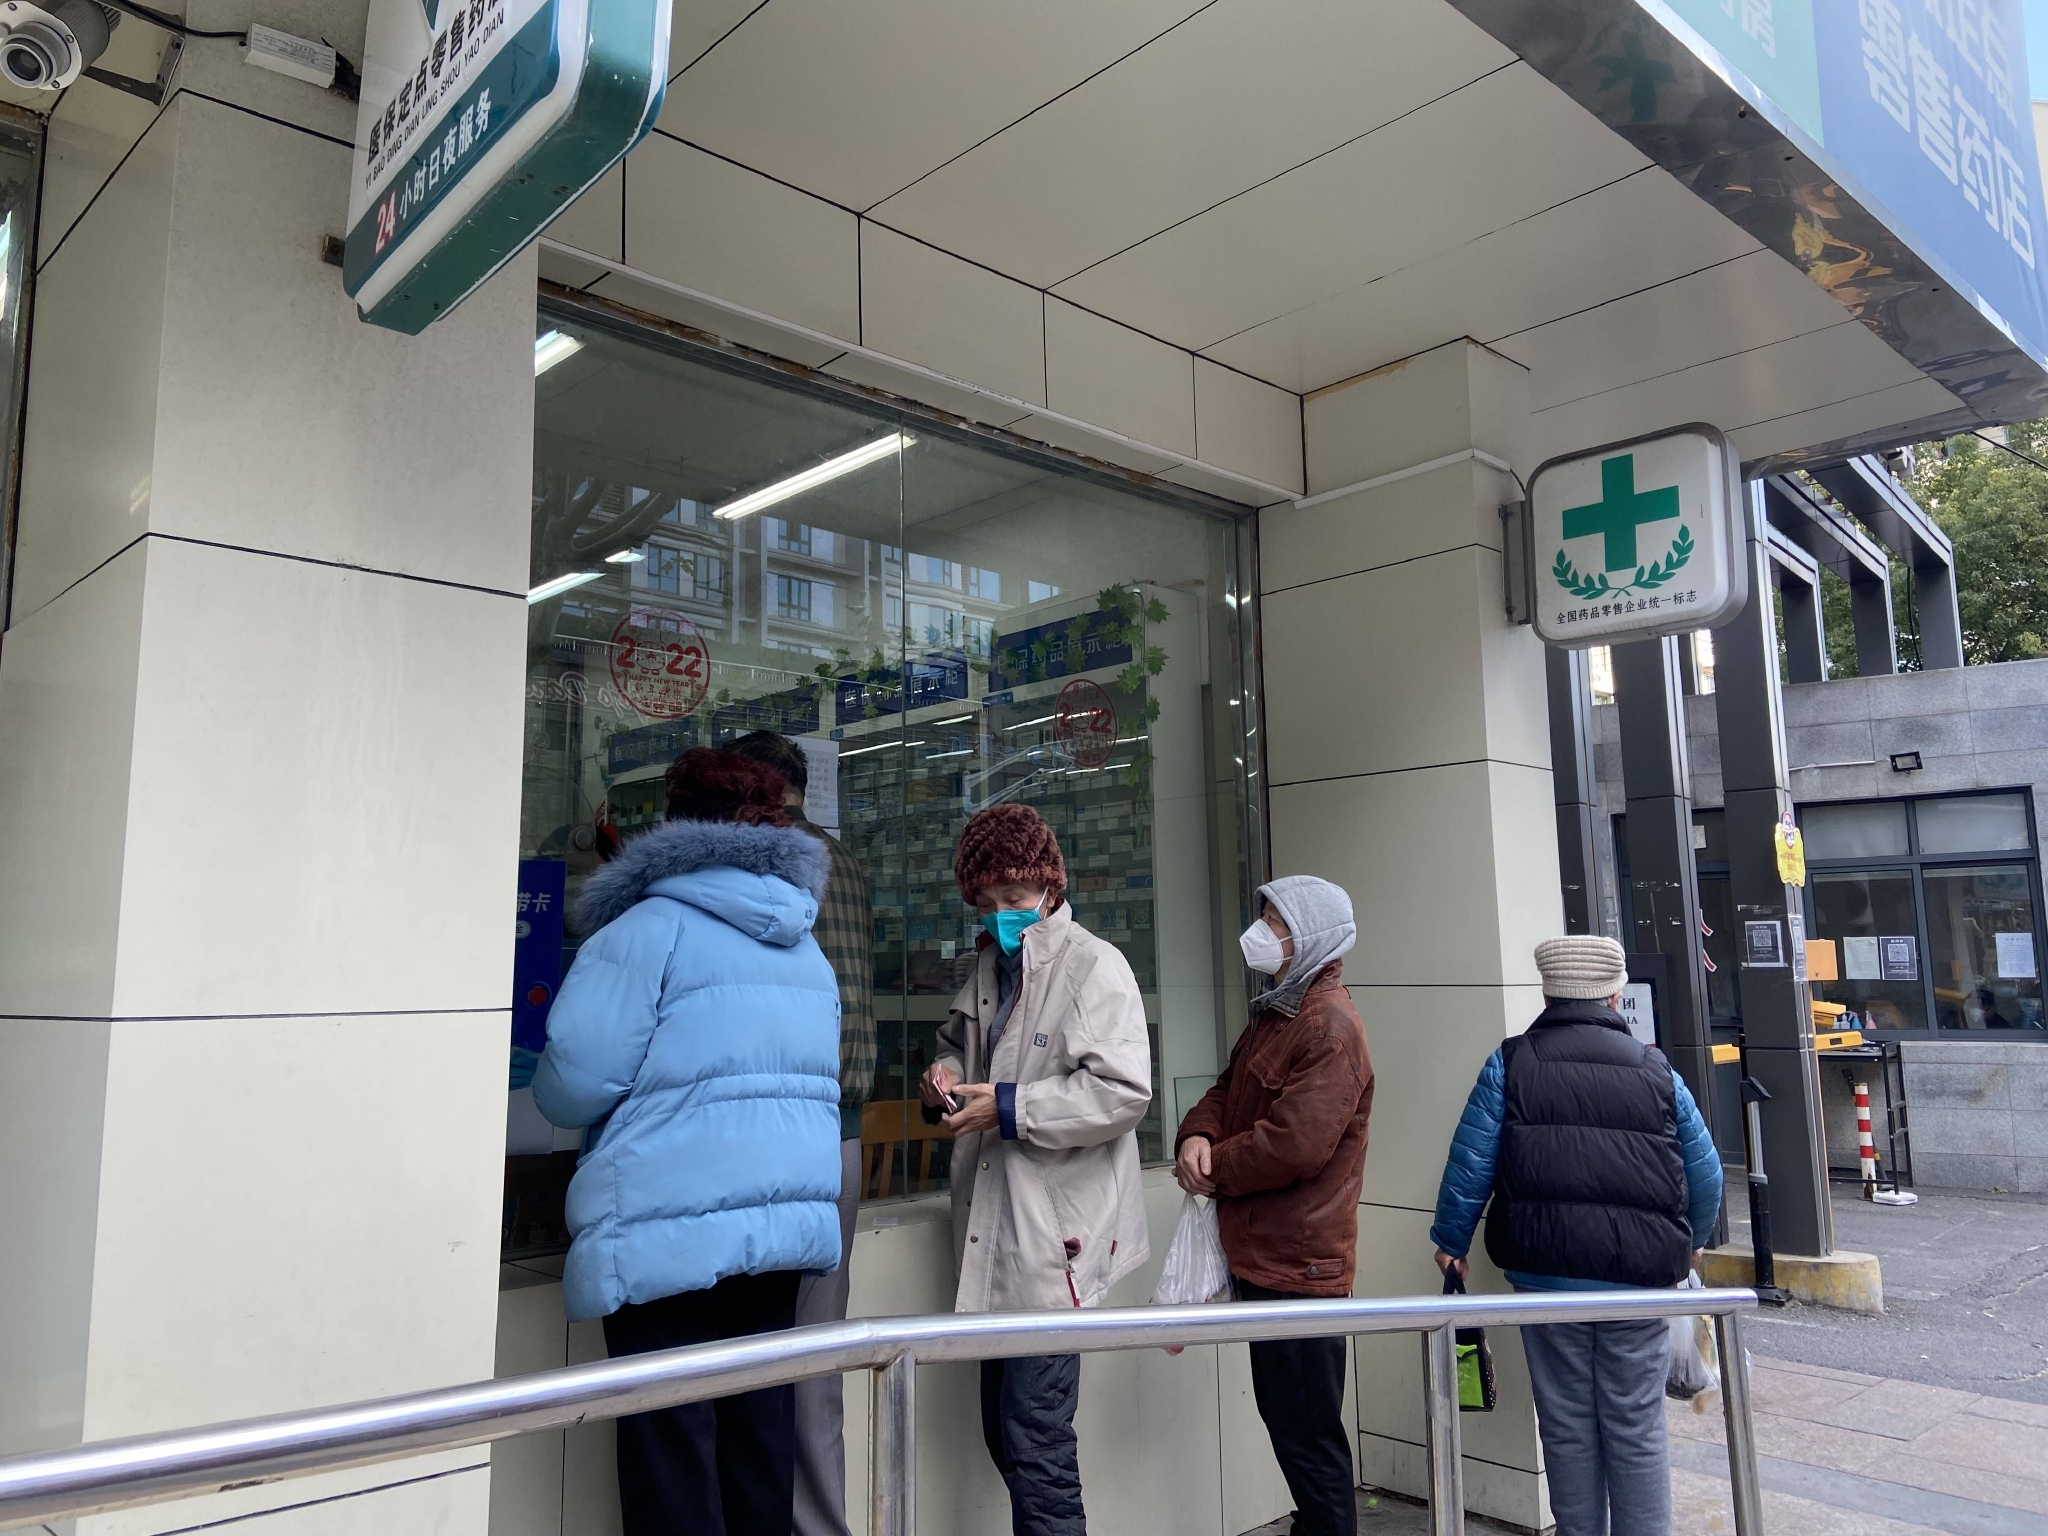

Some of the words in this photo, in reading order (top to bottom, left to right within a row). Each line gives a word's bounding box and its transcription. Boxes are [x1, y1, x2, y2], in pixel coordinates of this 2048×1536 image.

[365, 173, 373, 190] YI
[373, 157, 386, 182] BAO
[387, 134, 403, 164] DING
[404, 116, 420, 142] DIAN
[422, 90, 438, 120] LING
[440, 64, 461, 97] SHOU
[464, 37, 480, 68] YAO
[483, 7, 505, 45] DIAN
[367, 0, 498, 166] 医保定点零售药
[1858, 0, 2036, 270] 零售药店
[374, 186, 397, 258] 24
[399, 87, 492, 221] 小时日夜服务
[628, 674, 653, 683] HAPPY
[653, 677, 670, 686] NEW
[671, 680, 690, 688] YEAR
[1555, 589, 1698, 625] 全国药品零售企业统一标志
